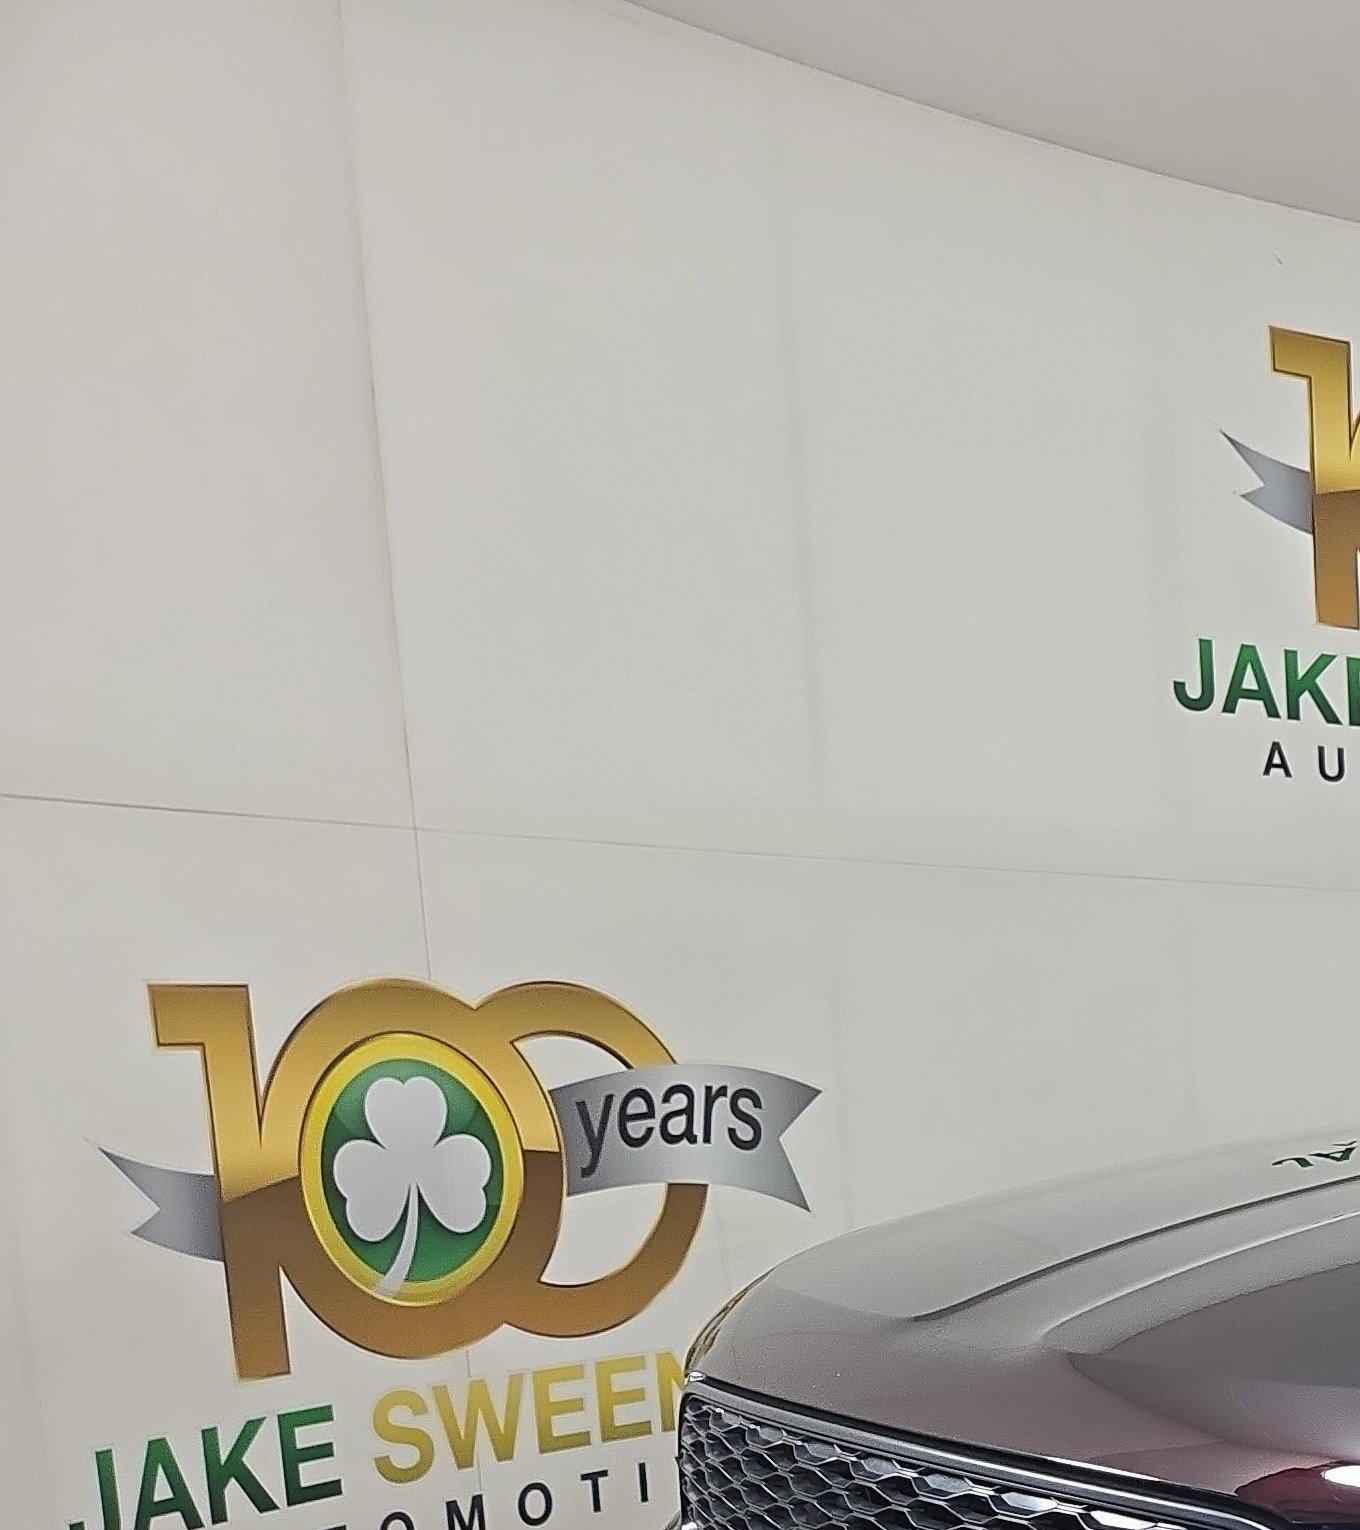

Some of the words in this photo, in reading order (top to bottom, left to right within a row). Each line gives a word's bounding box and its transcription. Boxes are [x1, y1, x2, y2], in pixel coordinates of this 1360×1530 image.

[147, 977, 708, 1382] 100
[575, 1083, 764, 1179] years
[371, 1350, 686, 1485] SWEEN
